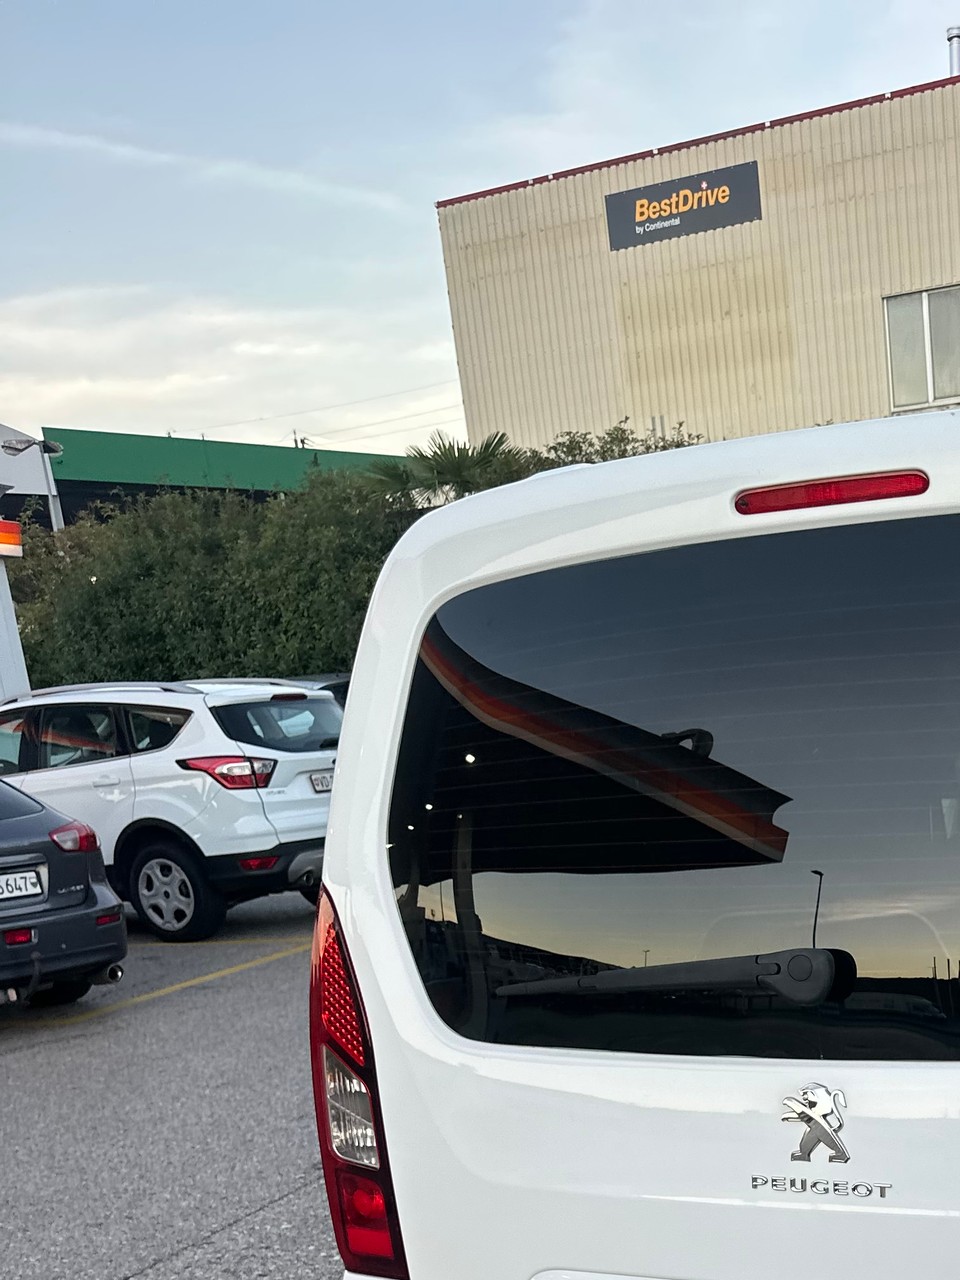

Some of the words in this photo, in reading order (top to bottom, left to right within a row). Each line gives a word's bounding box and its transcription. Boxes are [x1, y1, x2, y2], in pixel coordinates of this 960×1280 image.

[635, 181, 731, 223] BestDrive
[635, 226, 644, 235] by
[644, 217, 681, 232] Continental
[751, 1174, 893, 1199] PEUGEOT
